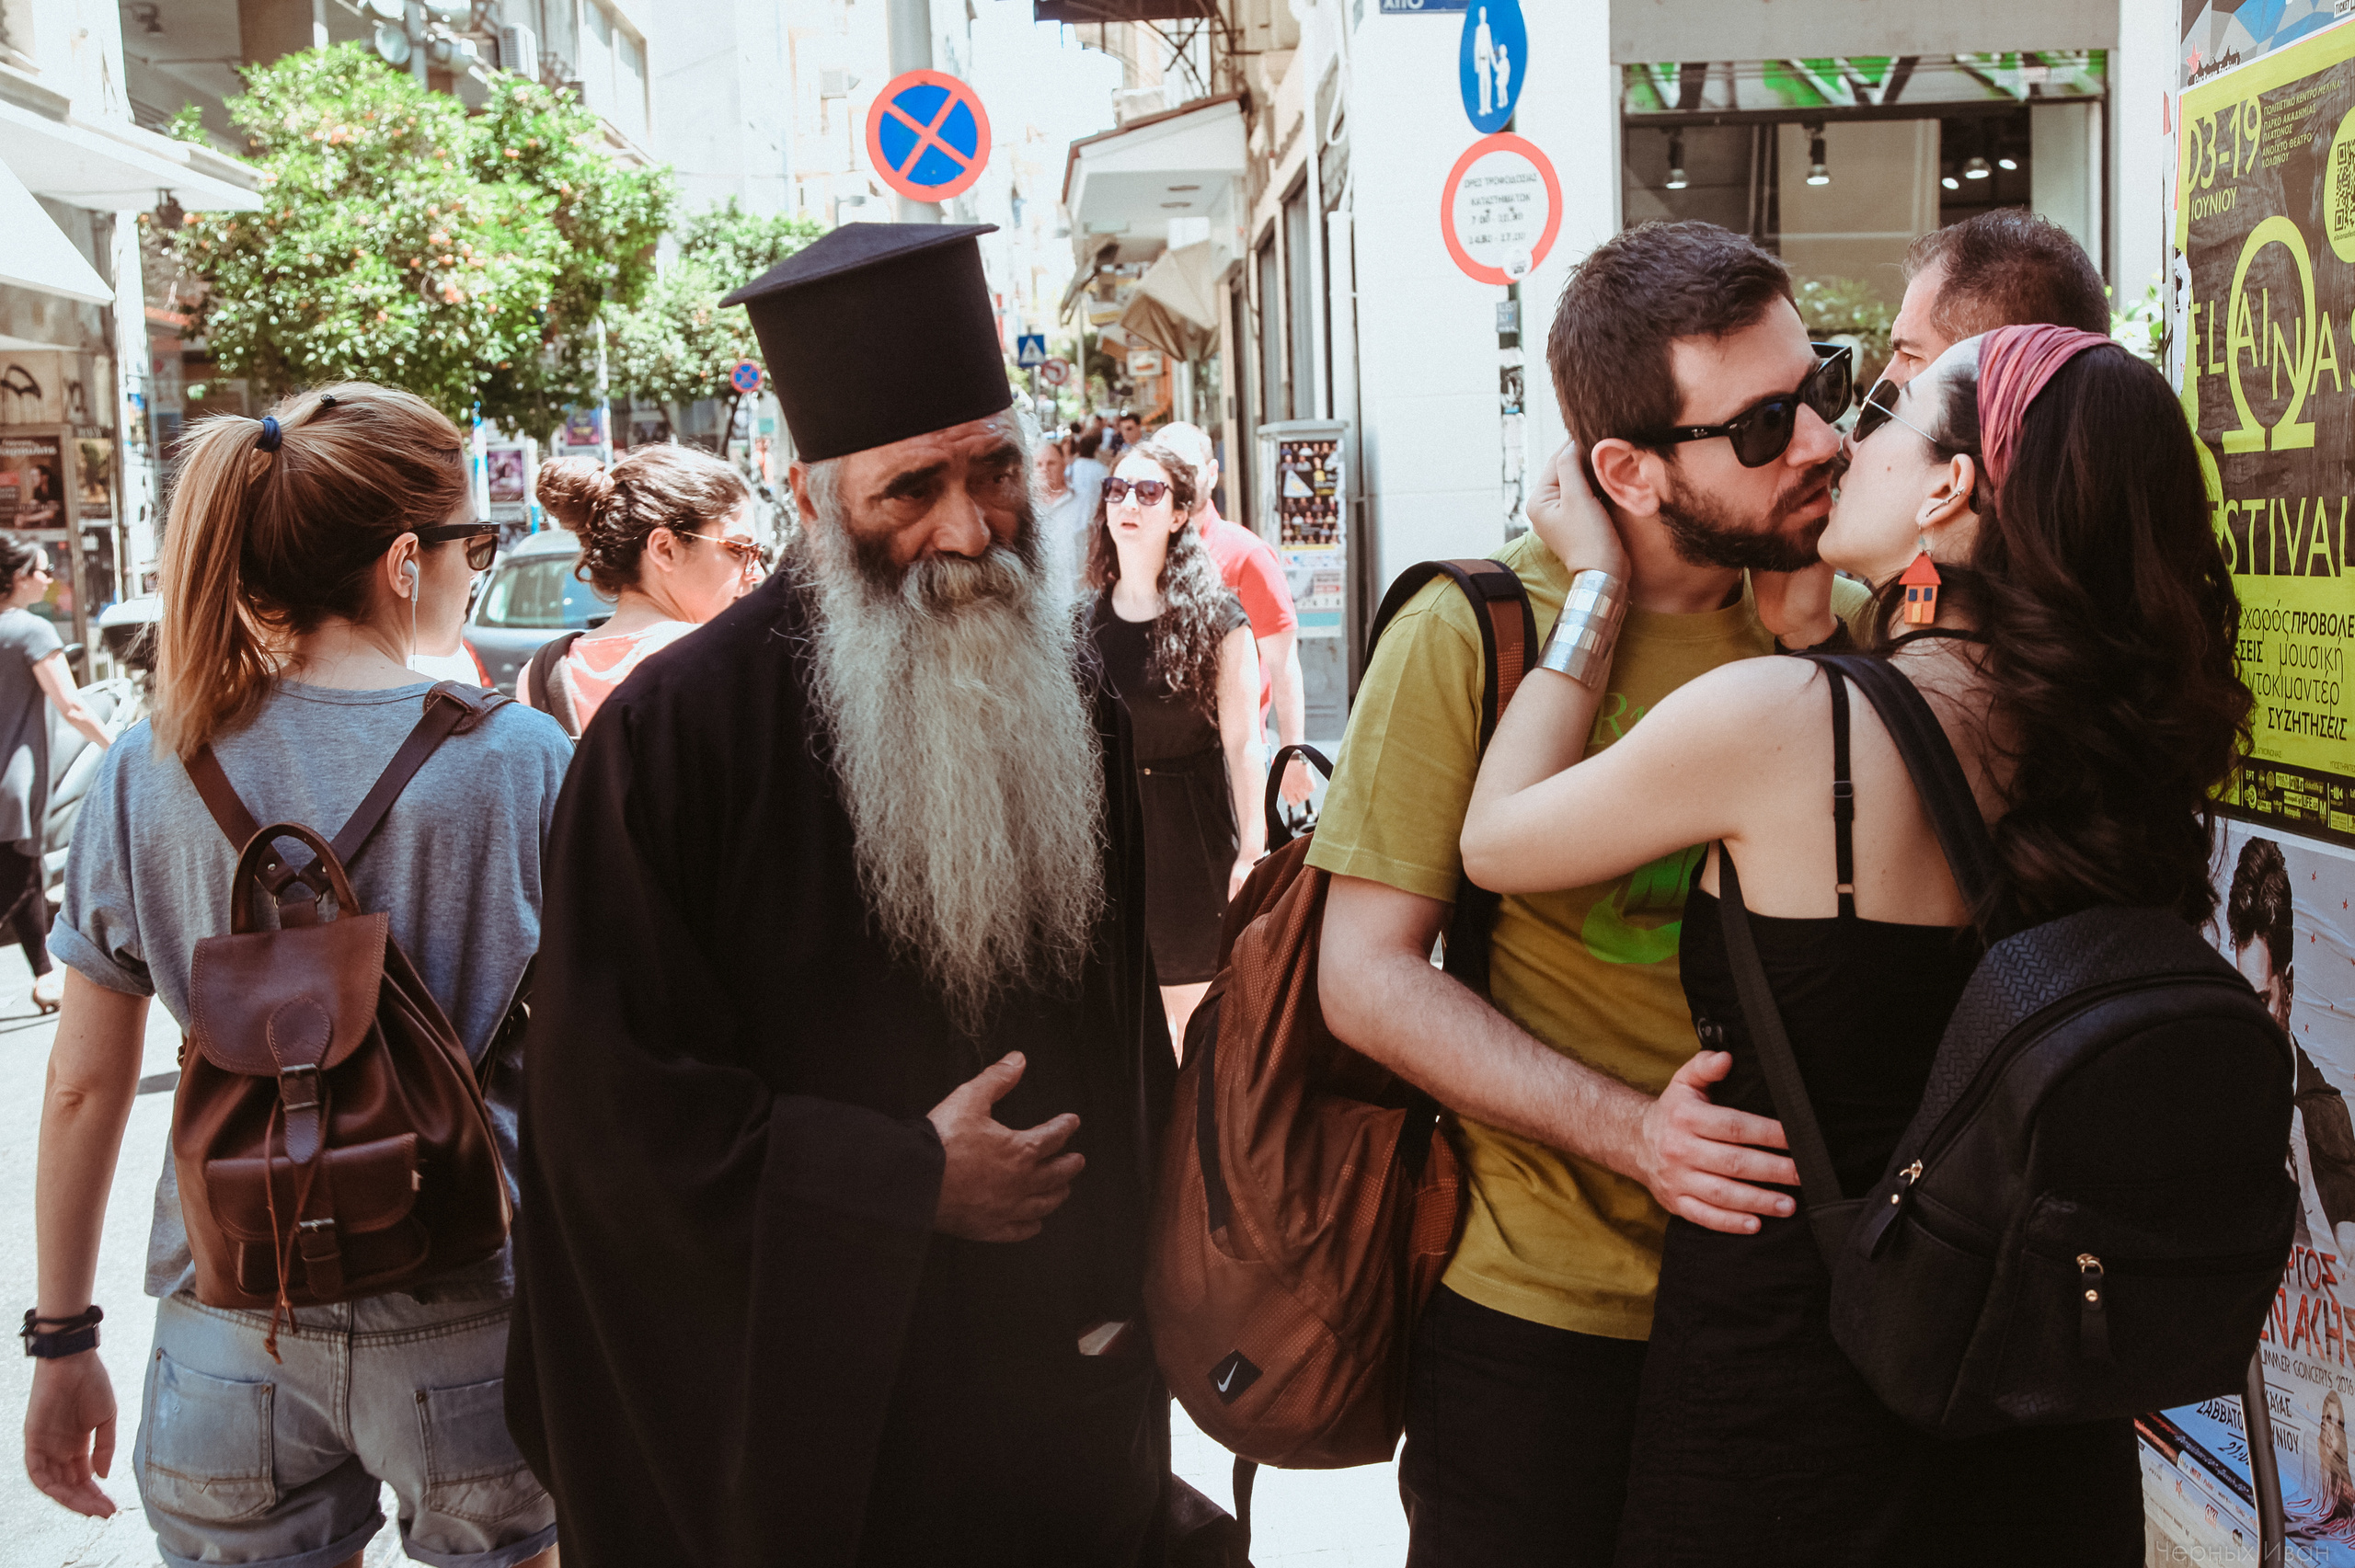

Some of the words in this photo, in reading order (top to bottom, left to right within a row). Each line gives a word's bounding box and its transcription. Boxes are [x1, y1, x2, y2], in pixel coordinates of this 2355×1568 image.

[2190, 187, 2238, 223] ΙΟΥΝΙΟΥ
[2211, 496, 2348, 578] STIVAL
[2280, 636, 2344, 683] μουσική
[2268, 706, 2348, 741] ΣΥΖΗΤΗΣΕΙΣ
[2292, 1359, 2333, 1389] CONCERTS
[2336, 1375, 2354, 1396] 2016
